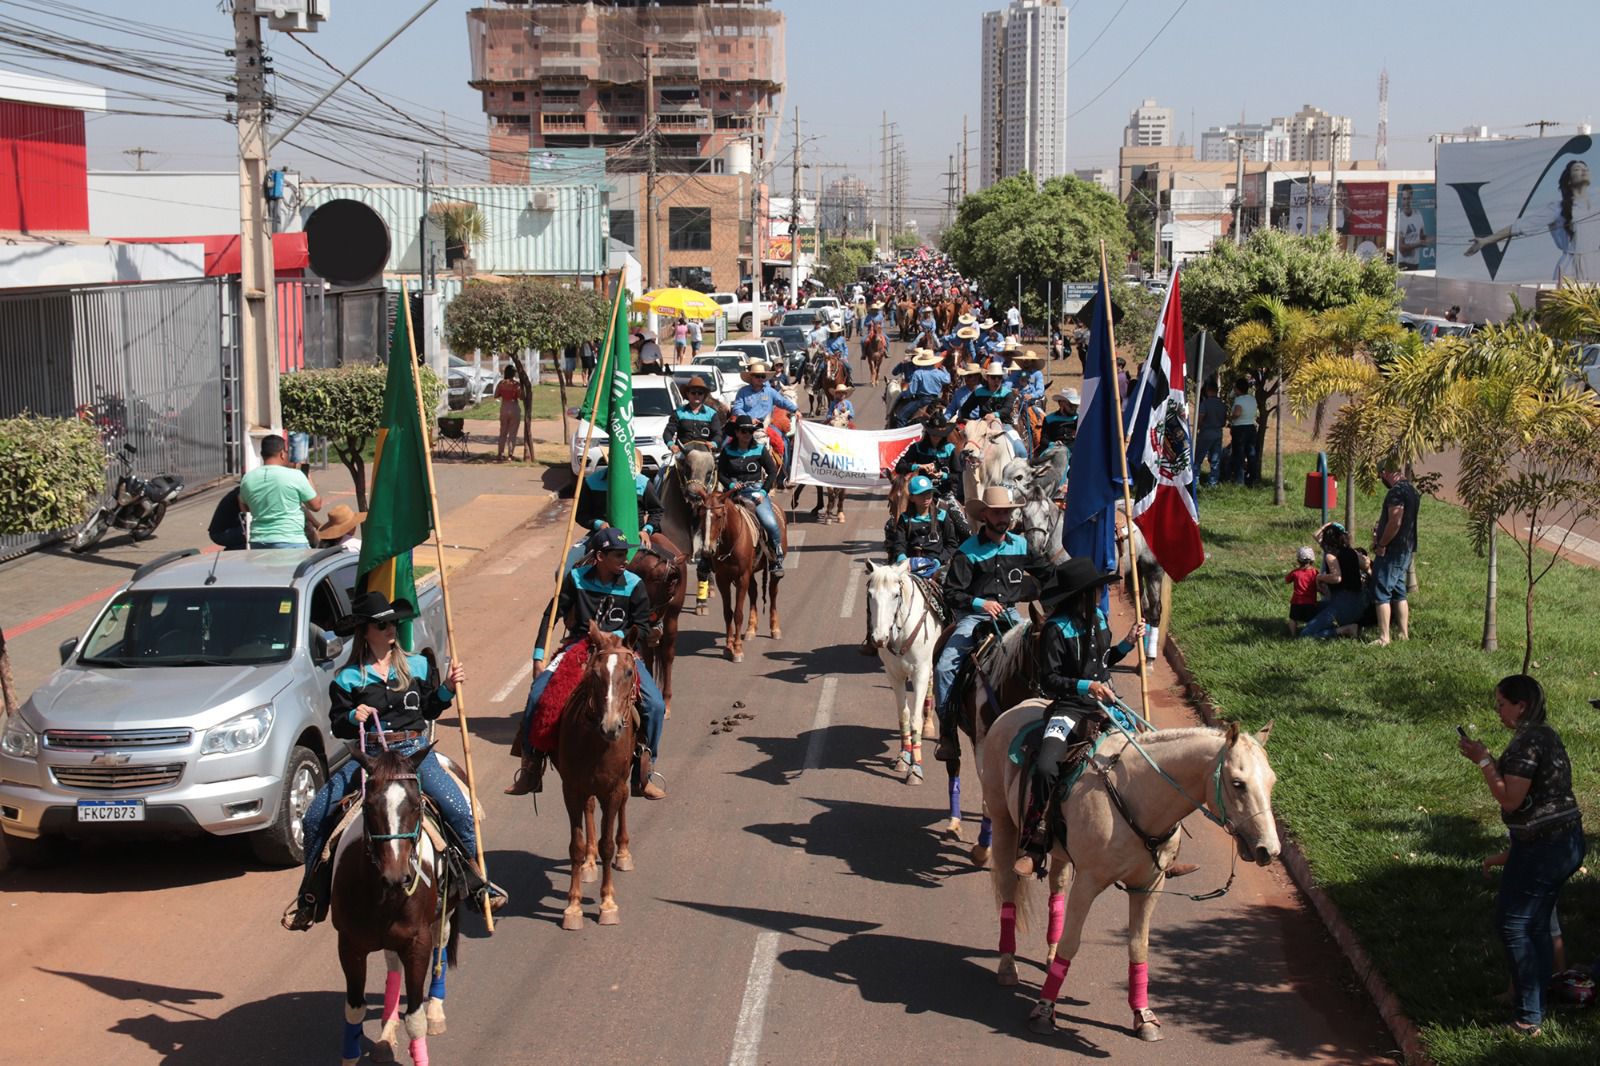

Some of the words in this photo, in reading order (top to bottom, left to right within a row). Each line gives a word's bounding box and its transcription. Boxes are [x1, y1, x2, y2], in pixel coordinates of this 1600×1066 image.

[610, 411, 627, 443] Mato
[810, 451, 867, 472] RAINH
[811, 467, 867, 480] VIDRAÇARIA
[84, 807, 136, 819] FKC7B73
